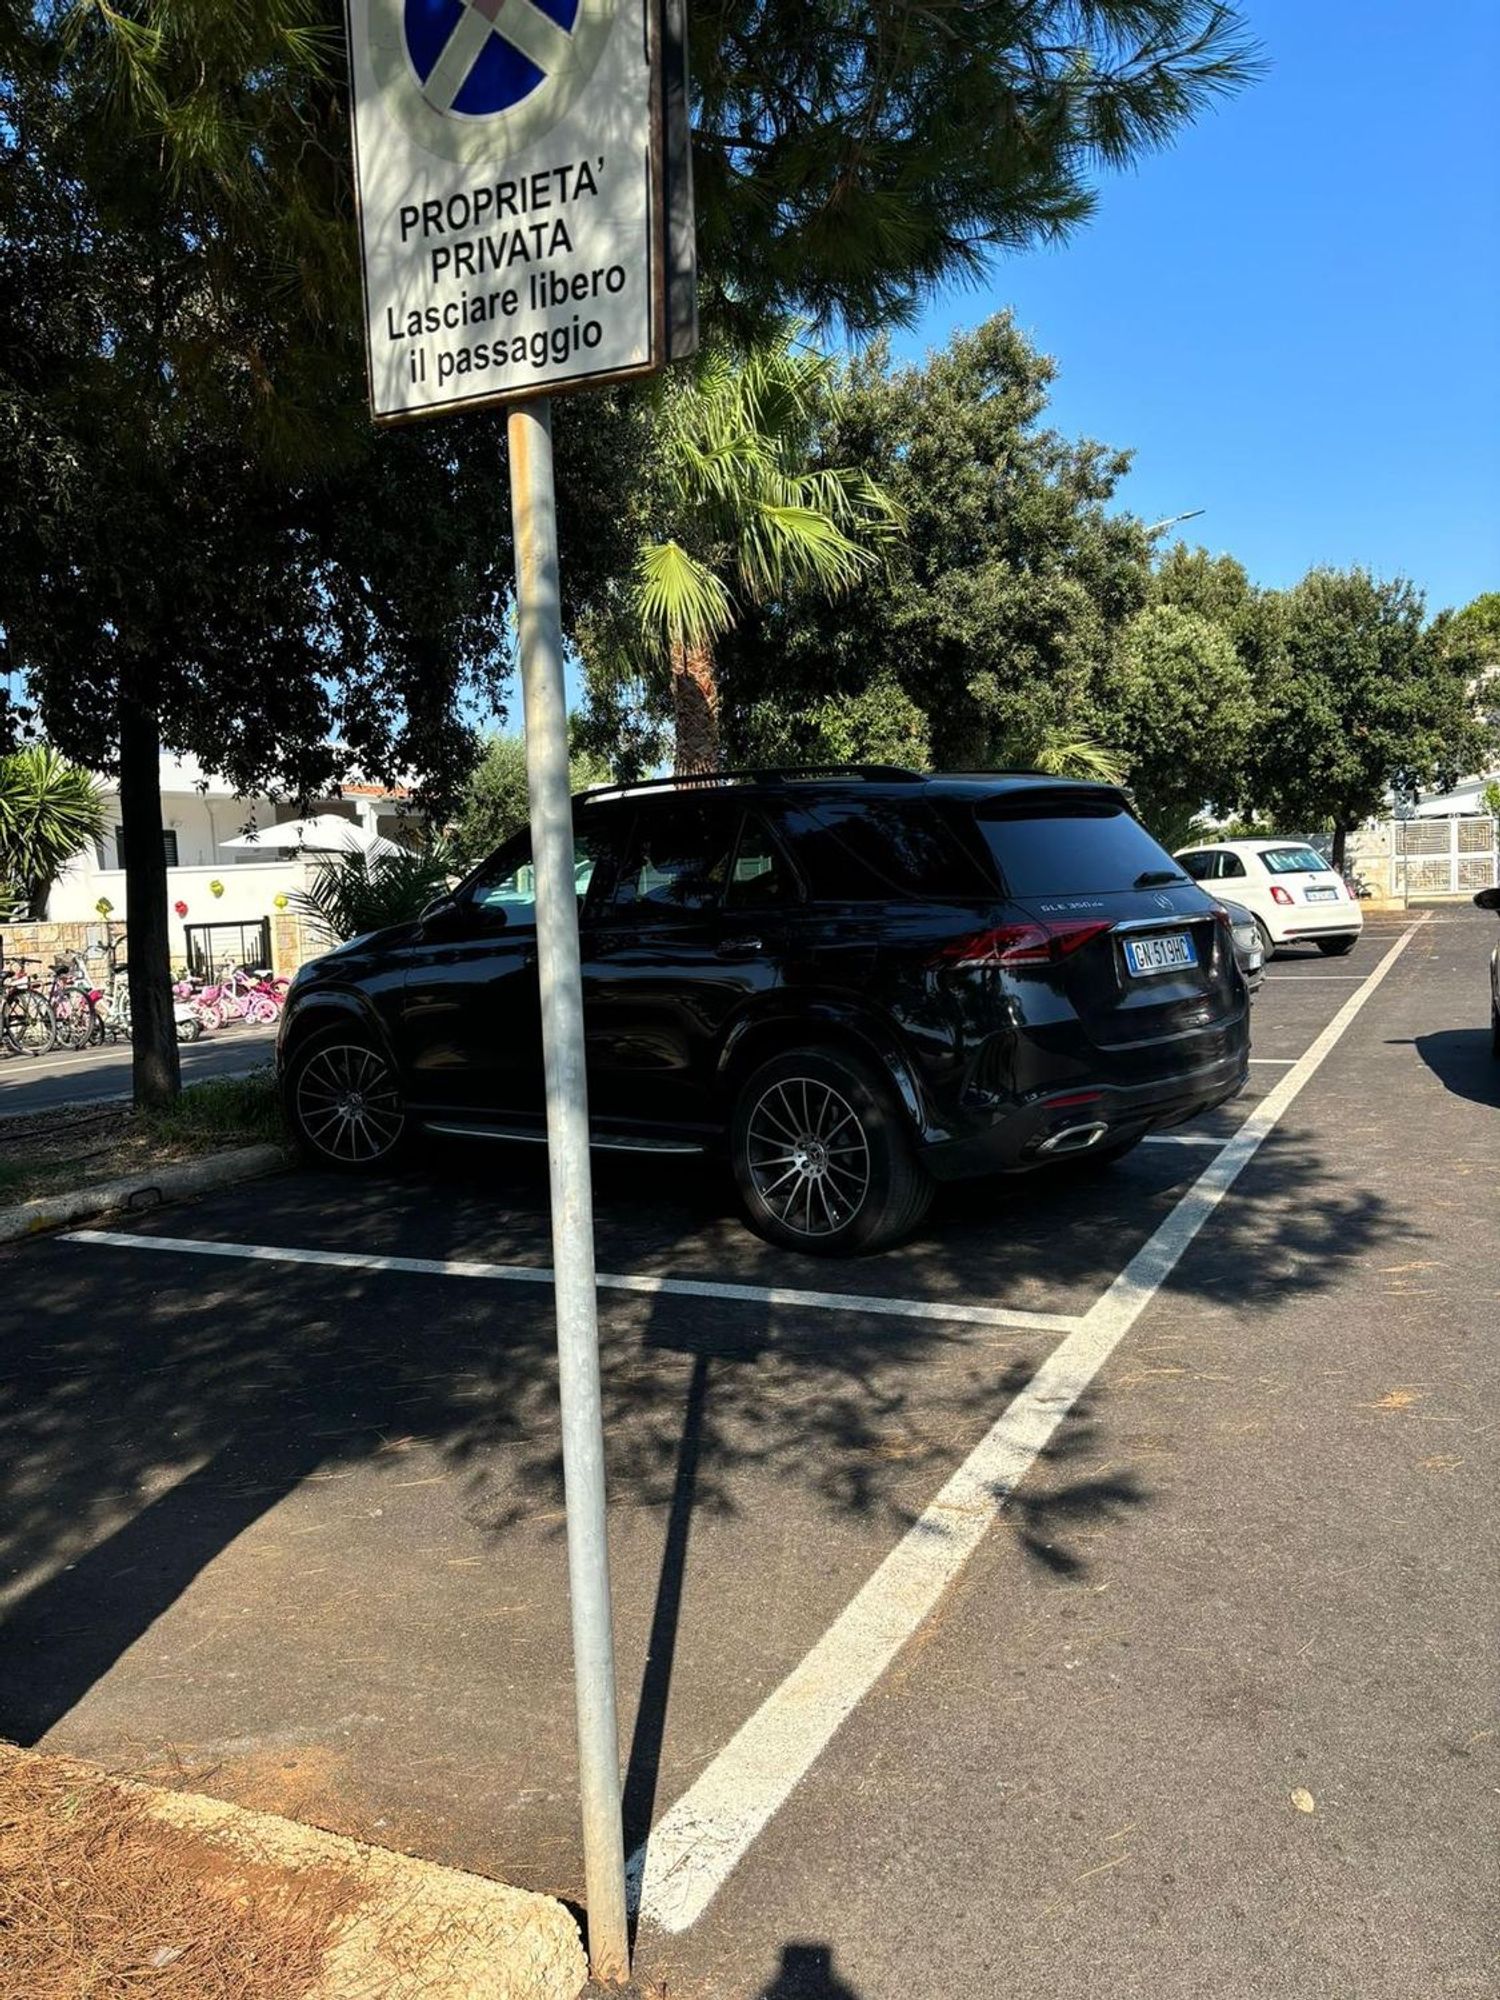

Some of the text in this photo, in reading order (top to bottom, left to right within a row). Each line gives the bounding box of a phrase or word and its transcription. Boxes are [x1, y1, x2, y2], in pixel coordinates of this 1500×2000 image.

[400, 157, 604, 241] PROPRIETA'
[432, 218, 573, 283] PRIVATA
[387, 265, 626, 340] Lasciare libero
[410, 315, 602, 386] il passaggio
